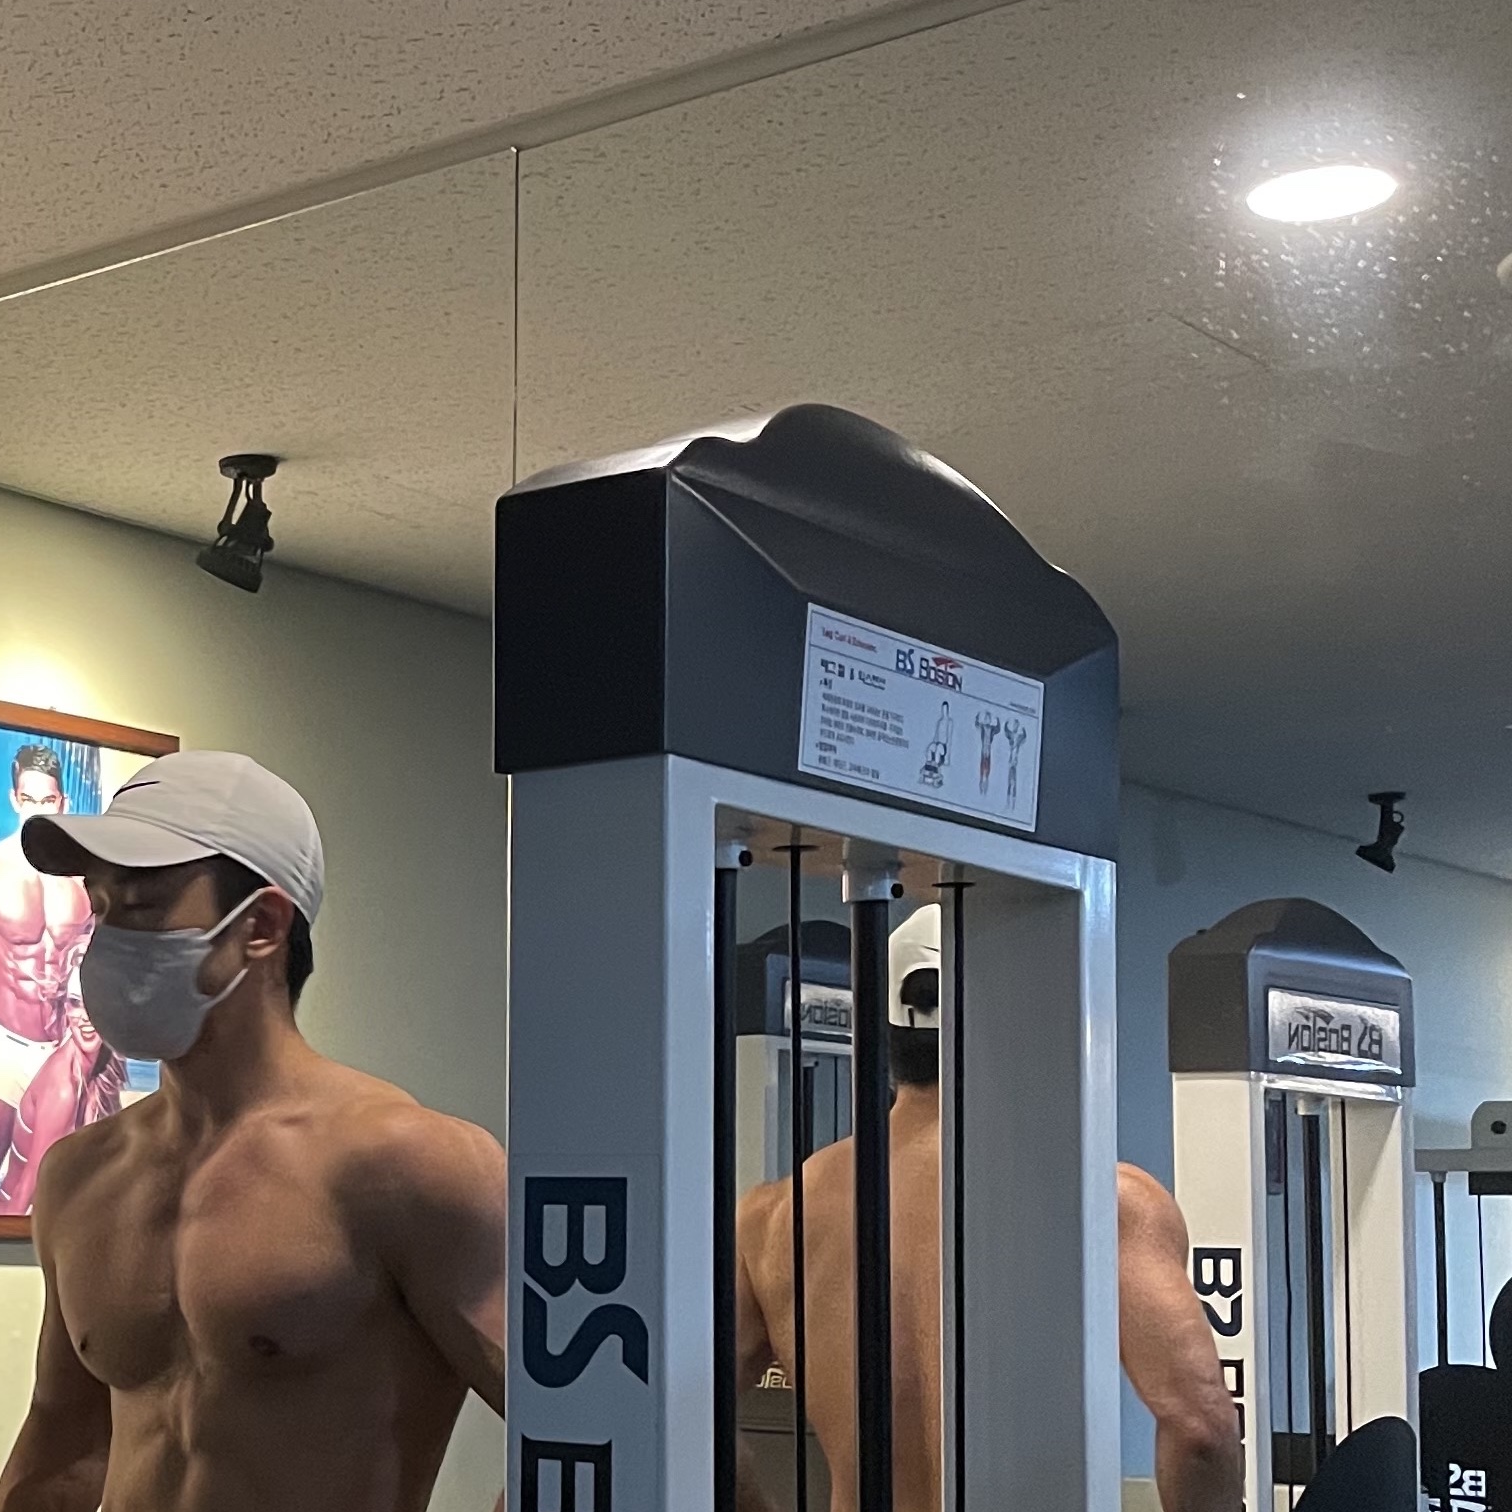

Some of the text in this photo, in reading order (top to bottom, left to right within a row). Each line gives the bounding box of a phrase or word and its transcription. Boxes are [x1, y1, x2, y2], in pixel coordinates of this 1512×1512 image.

[896, 648, 915, 676] BS
[919, 657, 964, 692] BOSTON
[522, 1176, 649, 1388] BS
